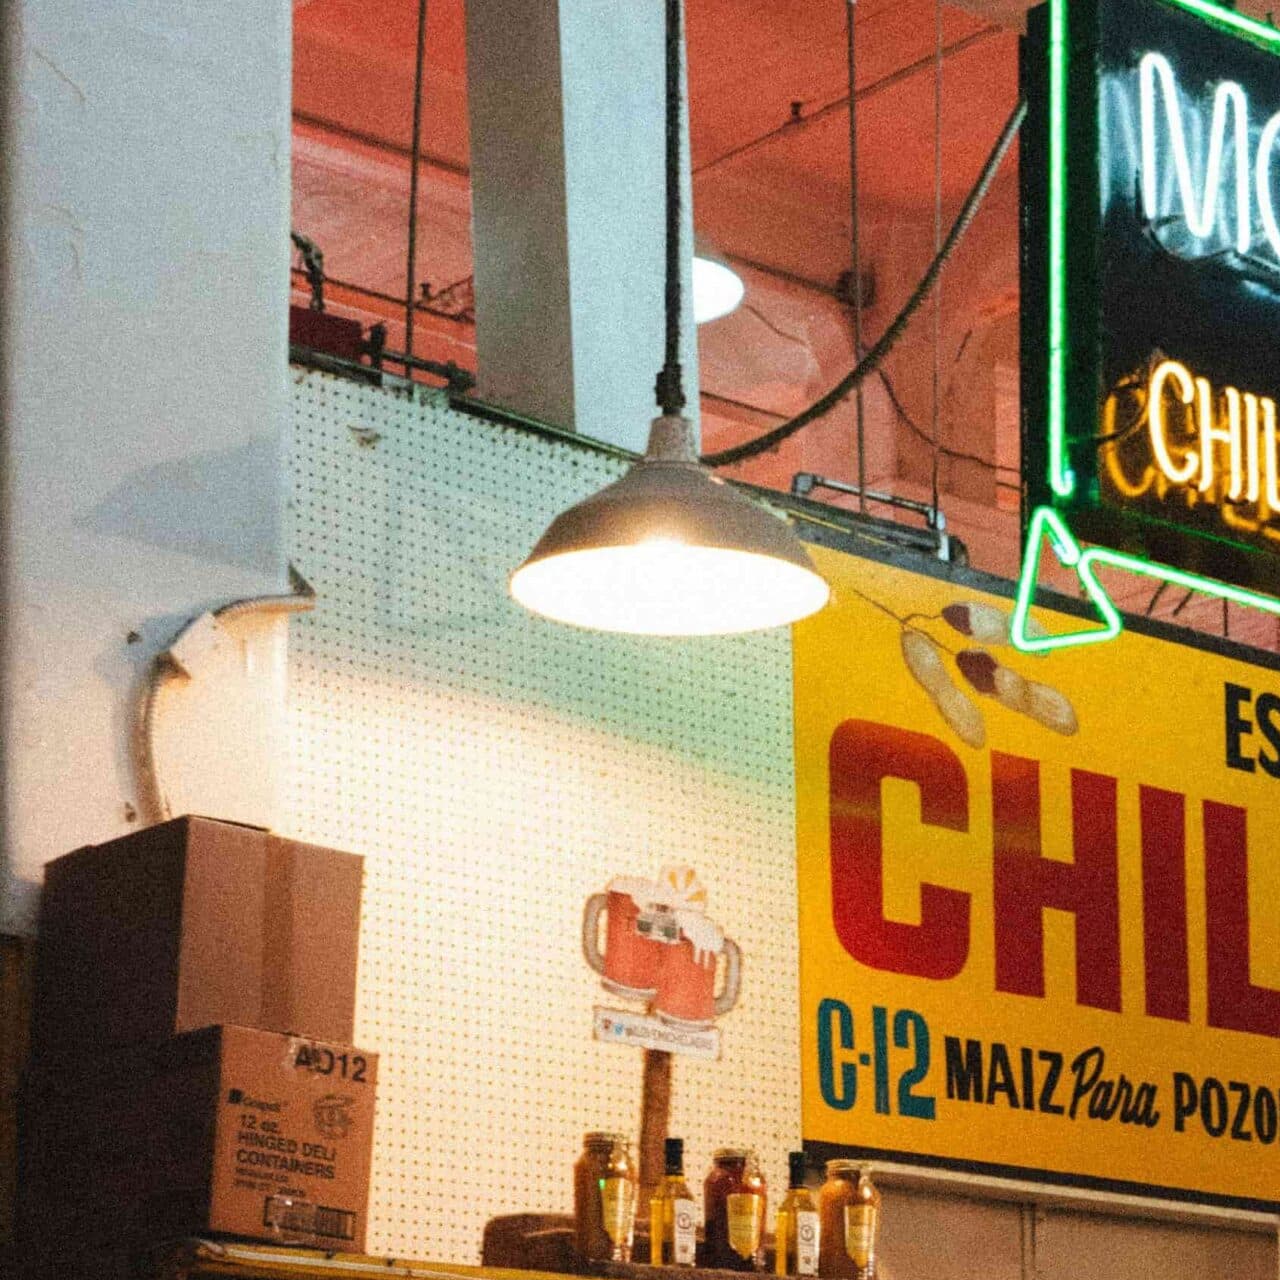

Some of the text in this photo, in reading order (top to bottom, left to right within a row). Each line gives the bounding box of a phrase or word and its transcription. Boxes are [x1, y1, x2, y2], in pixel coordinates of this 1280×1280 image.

[945, 1036, 1065, 1116] MAIZ
[1067, 1046, 1161, 1129] Para
[238, 1131, 337, 1161] HINGED DELI
[236, 1149, 335, 1180] CONTAINERS
